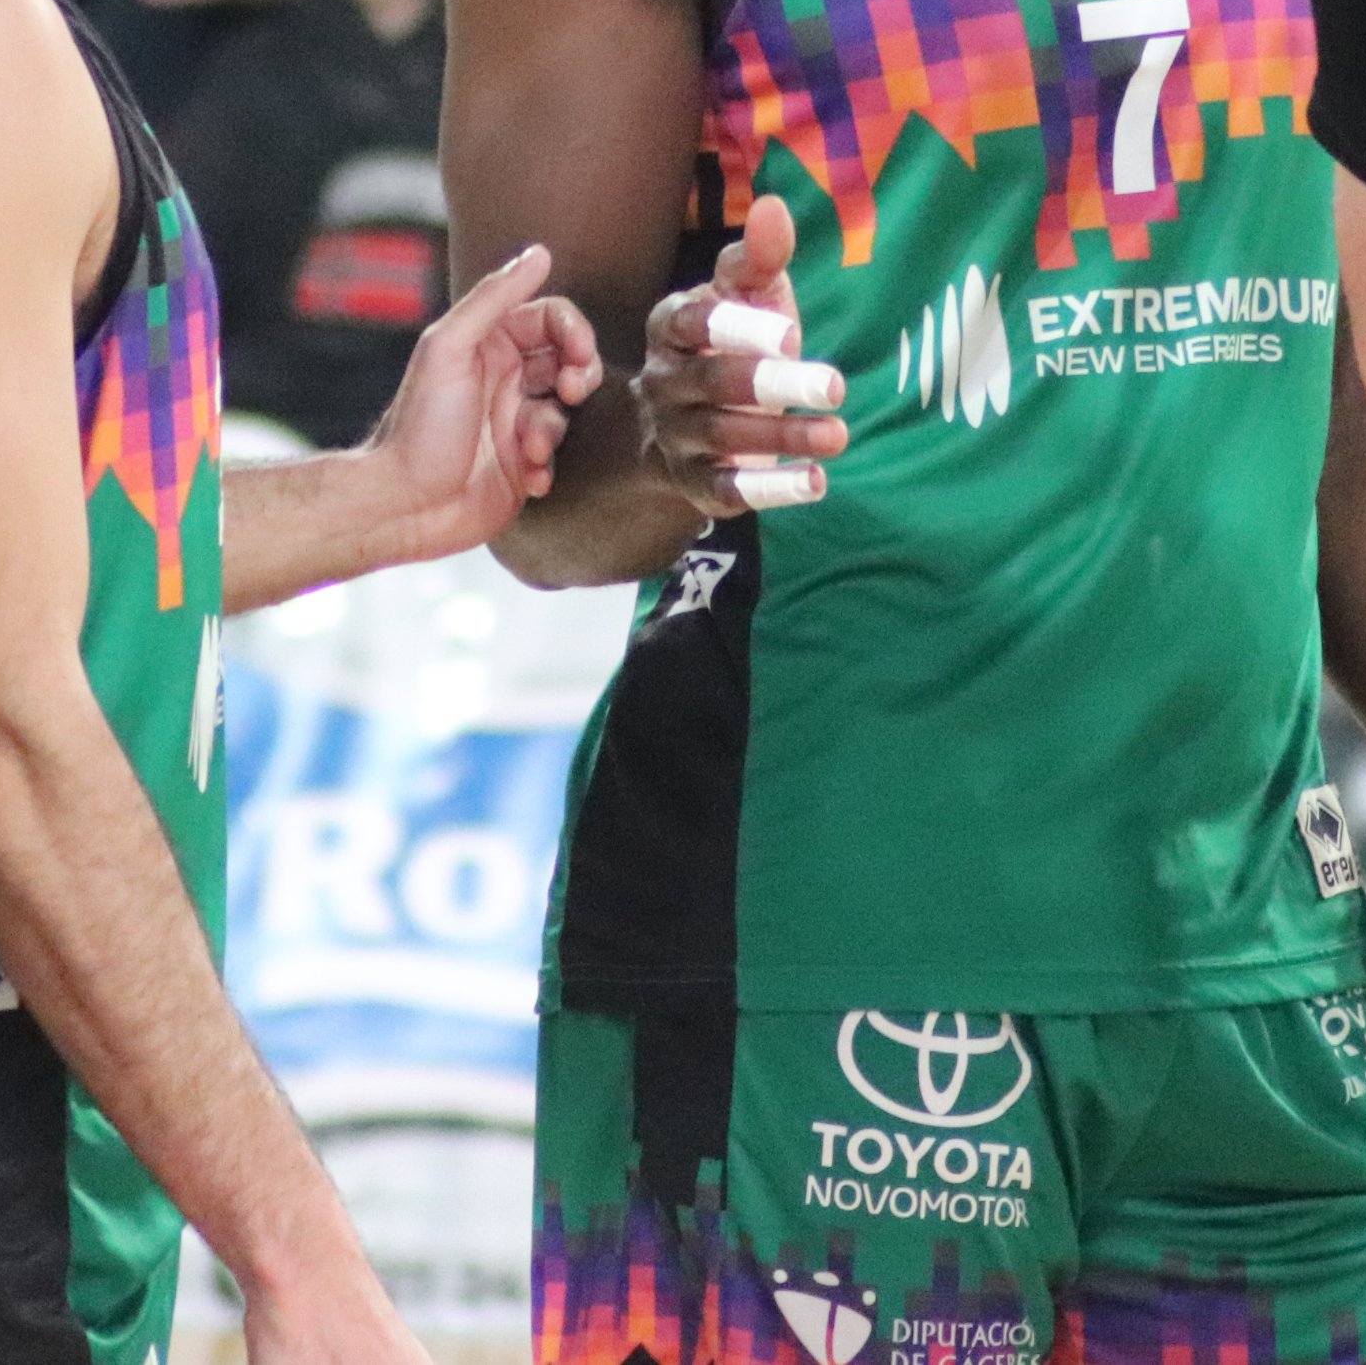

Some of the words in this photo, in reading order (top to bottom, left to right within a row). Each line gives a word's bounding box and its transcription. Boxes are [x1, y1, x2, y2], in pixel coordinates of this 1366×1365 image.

[1036, 345, 1125, 377] NEW
[1134, 334, 1283, 373] ENERGIES
[811, 1121, 1032, 1190] TOYOTA
[805, 1174, 1029, 1228] NOVOMOTOR
